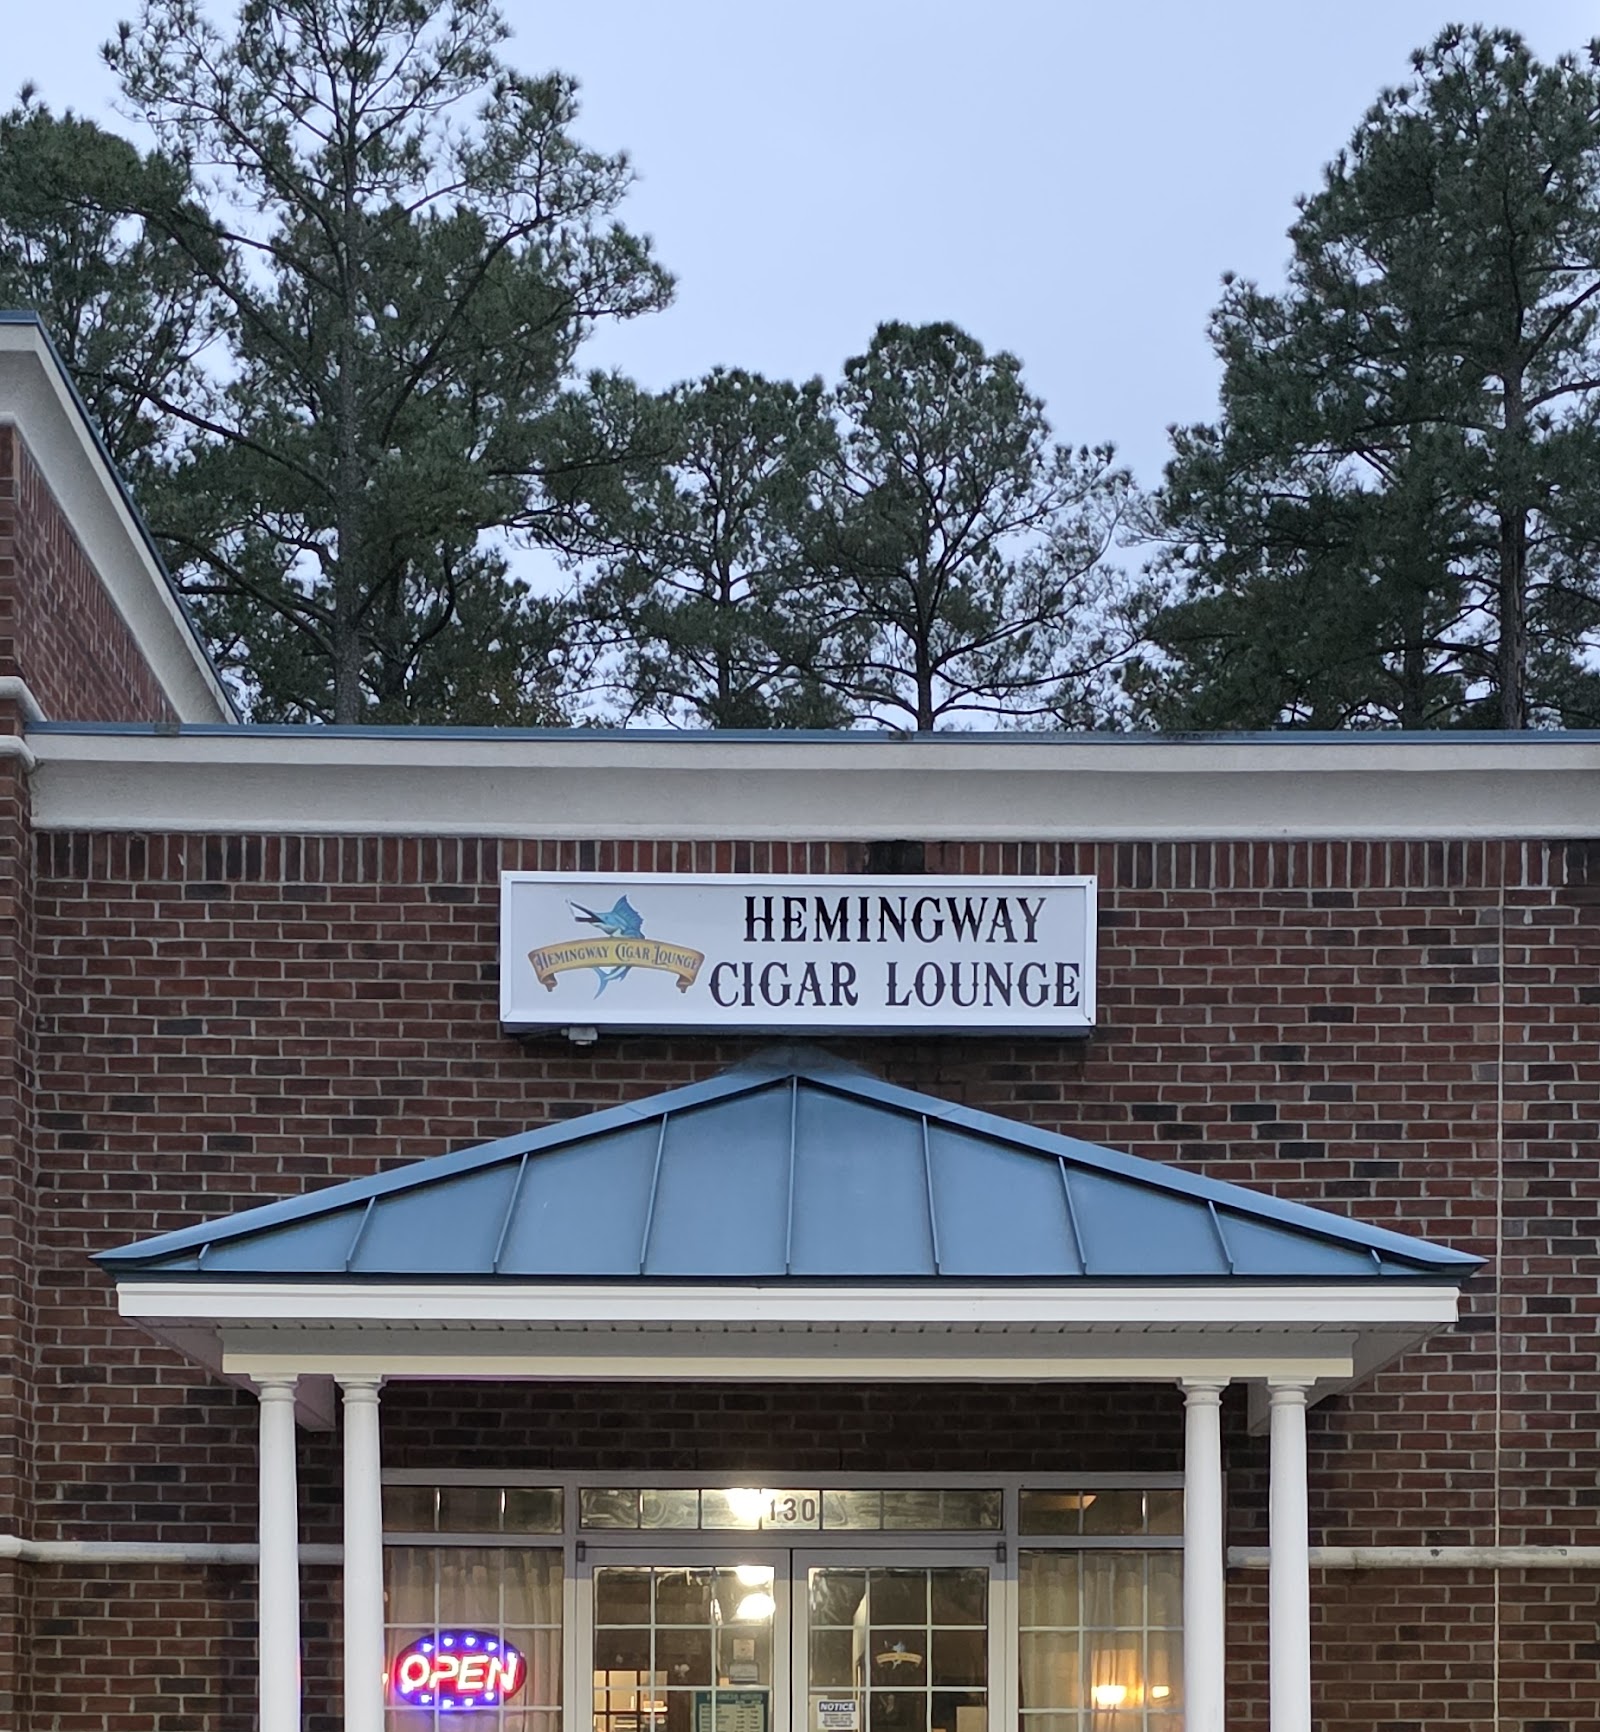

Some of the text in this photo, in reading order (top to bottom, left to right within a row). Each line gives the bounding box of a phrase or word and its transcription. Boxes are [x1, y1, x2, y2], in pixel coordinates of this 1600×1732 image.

[743, 896, 1047, 943] HEMINGWAY
[536, 943, 698, 971] HEMINGWAY CIGAR LOUNGE
[708, 961, 1080, 1007] CIGAR LOUNGE
[770, 1498, 816, 1521] 130
[401, 1652, 518, 1693] OPEN
[820, 1702, 854, 1711] NOTICE
